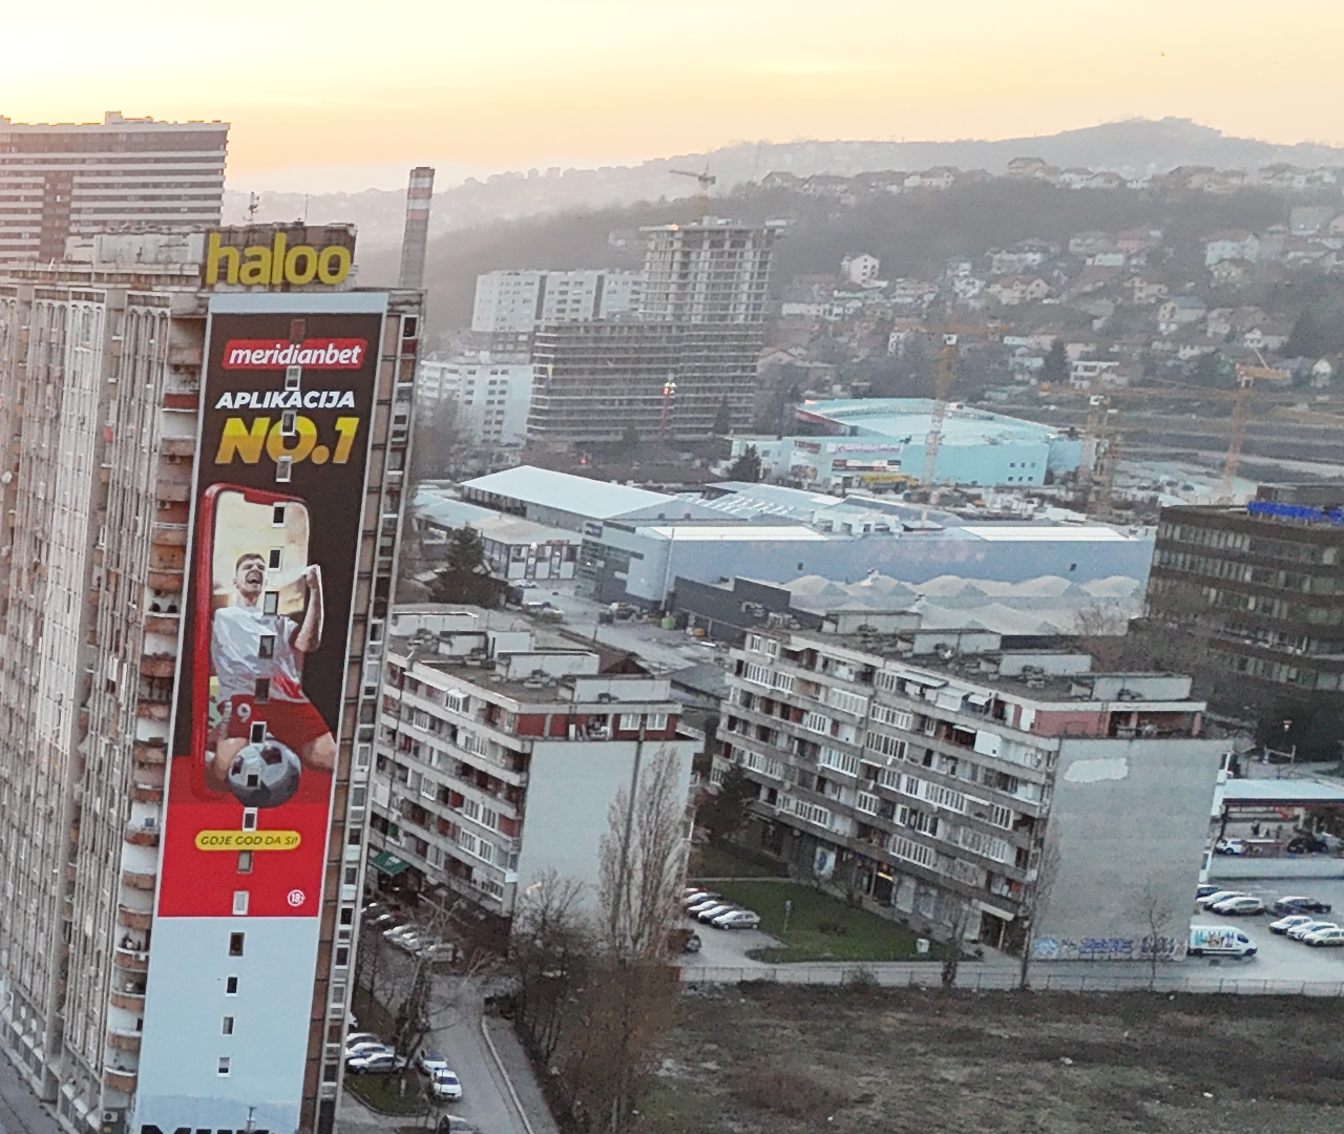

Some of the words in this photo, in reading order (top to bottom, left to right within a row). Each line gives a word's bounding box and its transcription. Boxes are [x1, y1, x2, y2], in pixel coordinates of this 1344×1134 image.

[206, 233, 352, 285] haloo
[228, 343, 362, 366] meridianbet
[215, 391, 356, 409] APLIKACIJA
[215, 417, 360, 464] NO.1
[200, 836, 231, 845] GDJE
[235, 836, 263, 845] GOD
[265, 836, 281, 845] DA
